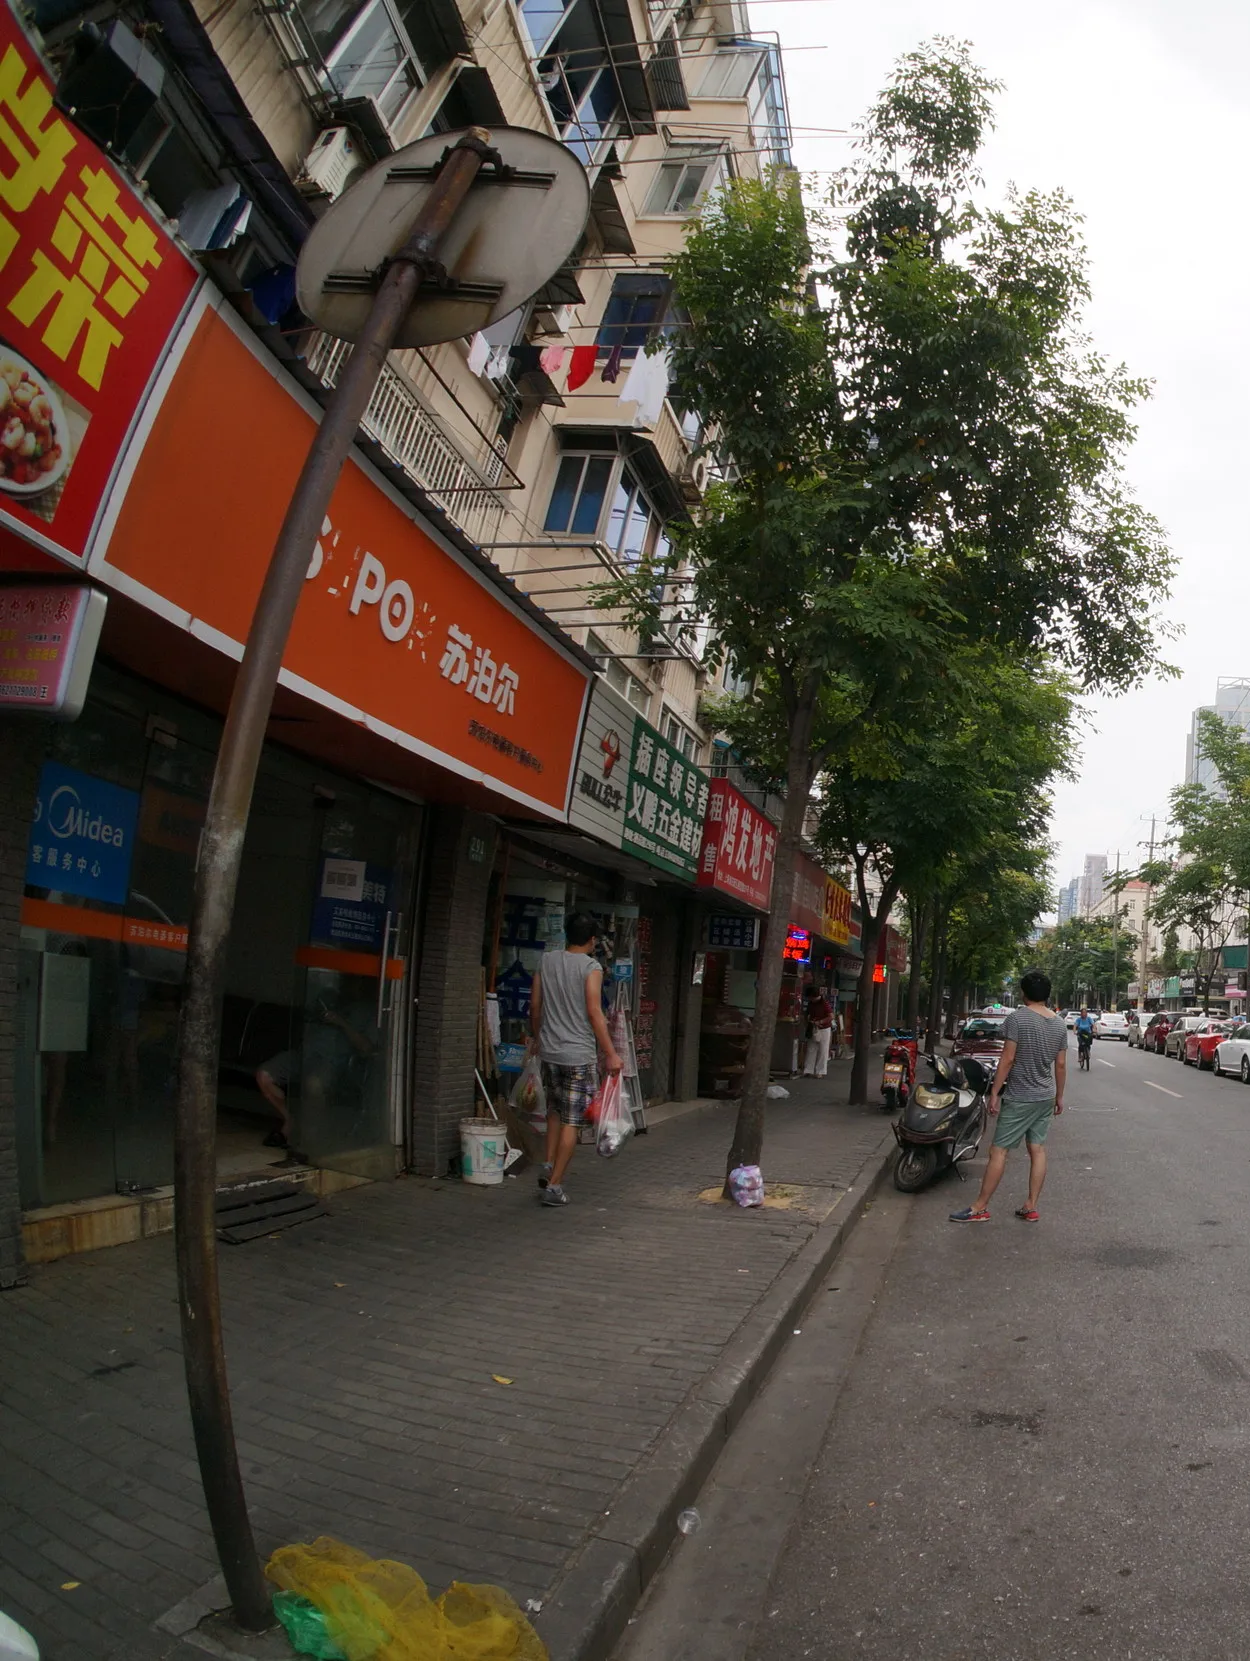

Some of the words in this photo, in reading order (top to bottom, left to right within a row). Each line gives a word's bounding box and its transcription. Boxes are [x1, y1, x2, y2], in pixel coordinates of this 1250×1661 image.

[438, 623, 519, 717] 苏泊尔
[48, 785, 124, 847] Midea
[635, 732, 709, 818] 插座领导者
[32, 845, 101, 878] 客服务中心
[721, 795, 775, 882] 鸿发地产
